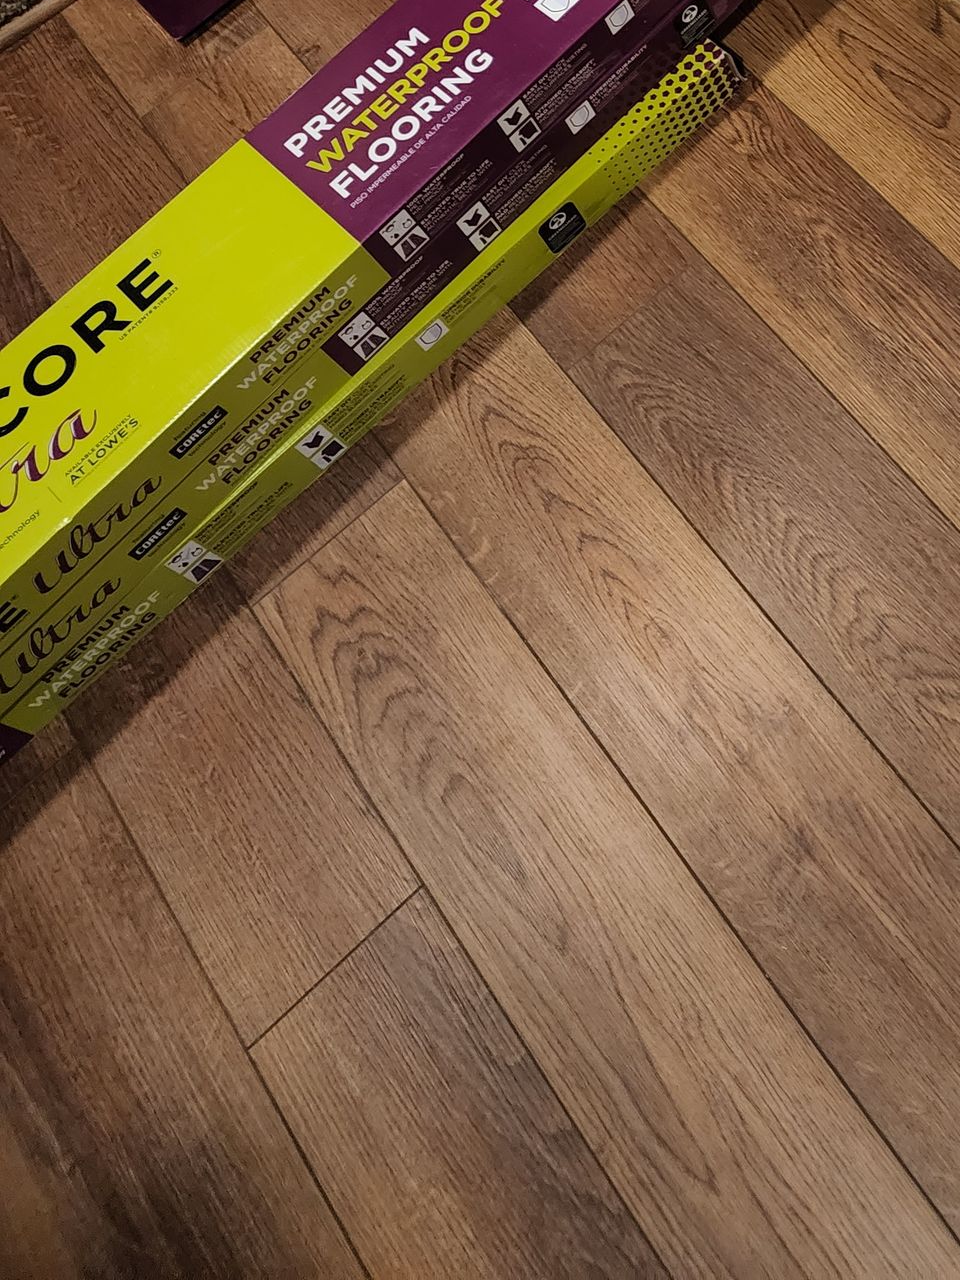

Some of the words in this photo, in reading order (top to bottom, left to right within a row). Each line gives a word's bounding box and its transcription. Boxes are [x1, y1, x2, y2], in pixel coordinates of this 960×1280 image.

[281, 24, 431, 160] PREMIUM
[327, 44, 497, 199] FLOORING
[349, 191, 369, 209] PISO
[365, 147, 416, 193] IMPERMEABLE
[413, 138, 426, 149] DE
[422, 121, 444, 140] ALTA
[440, 94, 473, 124] CALIDAD
[118, 332, 127, 340] US
[237, 275, 358, 390] WATERPROOF
[247, 286, 333, 364] PREMIUM
[260, 297, 355, 383] FLOORING
[63, 447, 96, 476] AVAILABLE
[94, 414, 132, 447] EXCLUSIVELY
[67, 465, 88, 484] AT
[85, 417, 140, 465] LOWE'S
[195, 377, 320, 491] WATERPROOF
[205, 388, 292, 466] PREMIUM
[219, 397, 315, 484] FLOORING
[28, 589, 163, 711] WATERPROOF
[40, 603, 130, 684] PREMIUM
[58, 608, 157, 698] FLOORING
